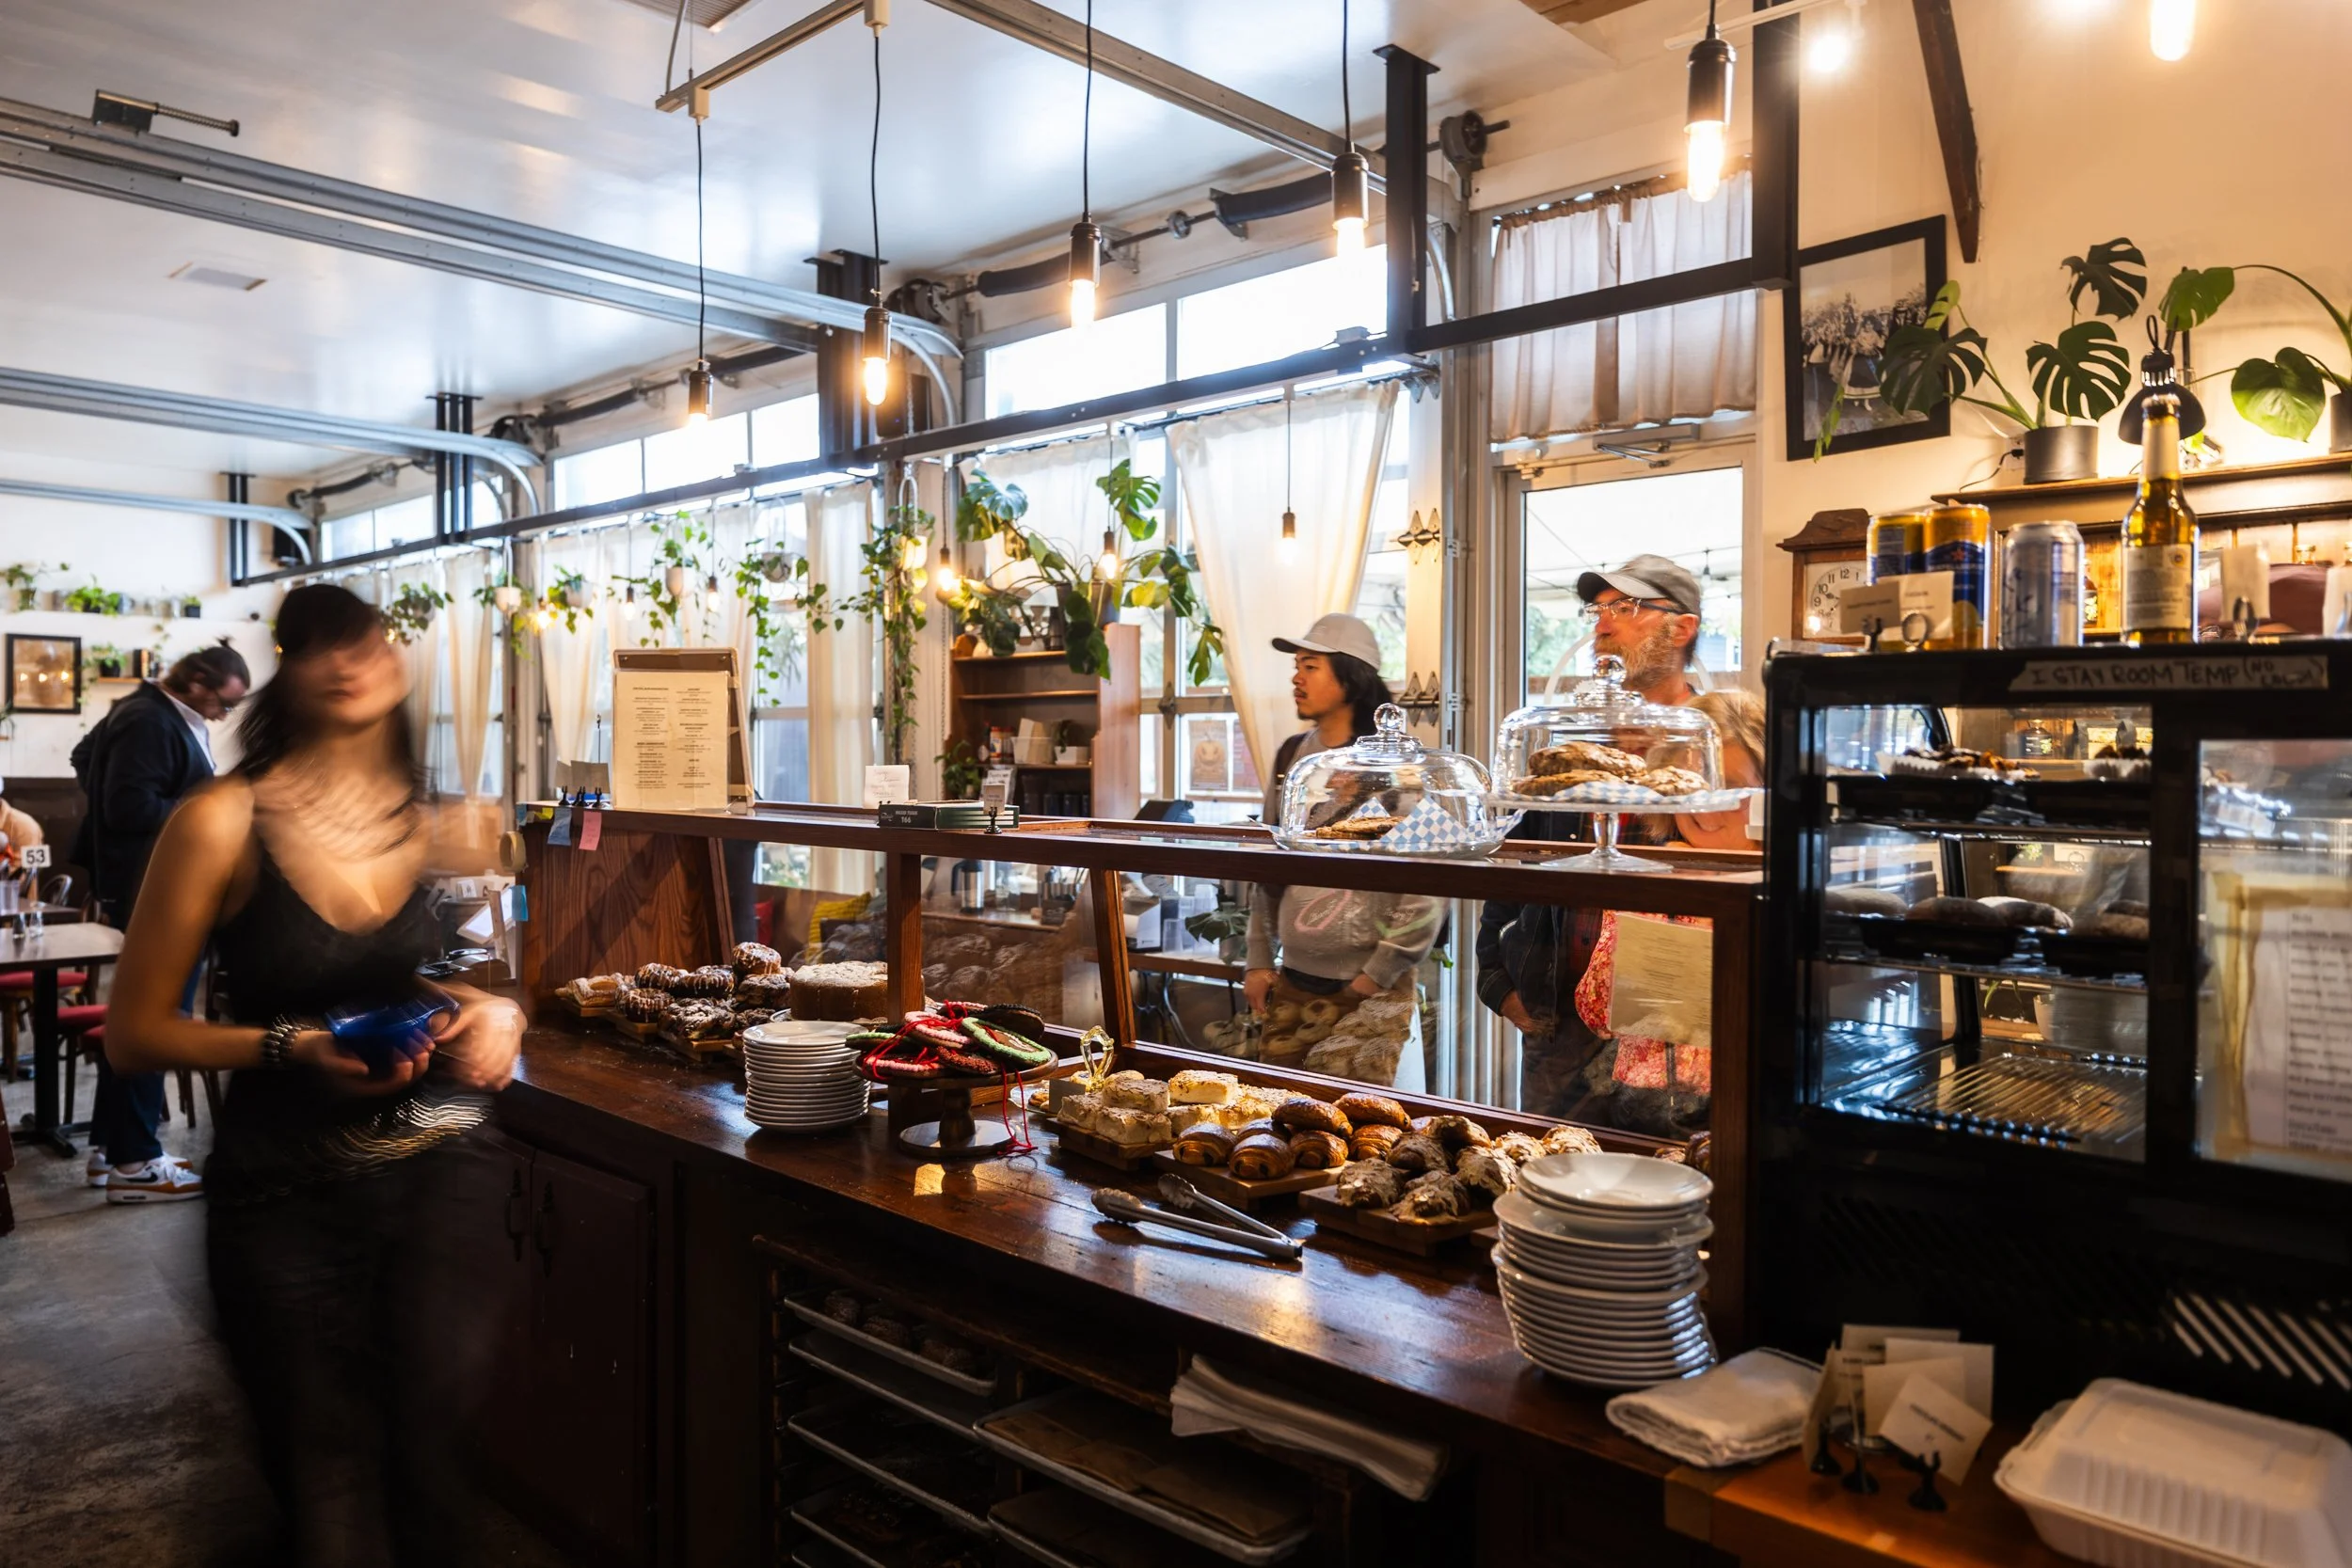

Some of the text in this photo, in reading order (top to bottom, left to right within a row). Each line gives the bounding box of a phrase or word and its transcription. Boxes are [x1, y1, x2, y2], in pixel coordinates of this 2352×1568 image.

[1828, 573, 1835, 584] 11
[1840, 568, 1850, 579] 12
[1818, 583, 1829, 594] 10
[1814, 596, 1821, 608] 9
[2031, 668, 2047, 685] I
[2052, 666, 2105, 688] STAY
[2110, 663, 2174, 686] ROOM
[2174, 660, 2239, 685] TEMP
[26, 848, 45, 864] 53
